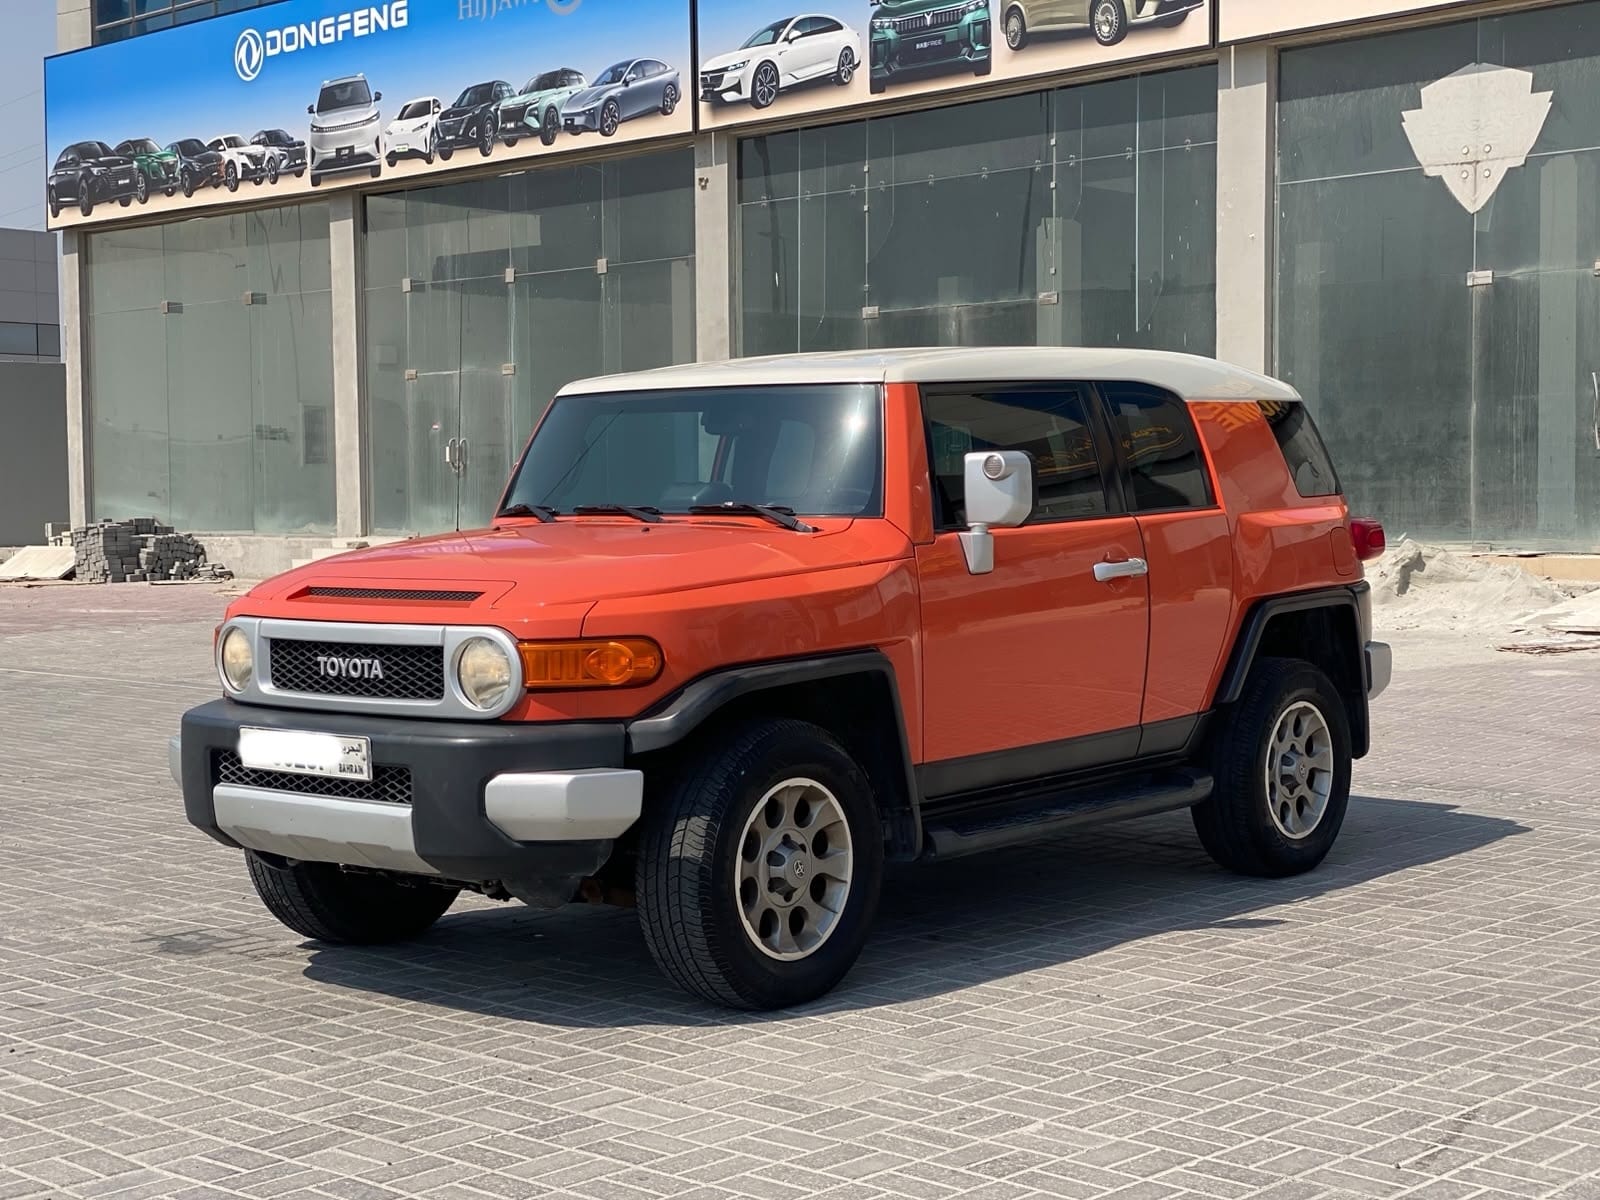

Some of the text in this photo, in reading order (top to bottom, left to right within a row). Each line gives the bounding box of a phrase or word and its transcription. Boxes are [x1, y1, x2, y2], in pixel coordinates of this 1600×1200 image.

[265, 0, 408, 57] DONGFENG
[317, 656, 383, 679] TOYOTA
[338, 762, 364, 775] BAHRAIN
